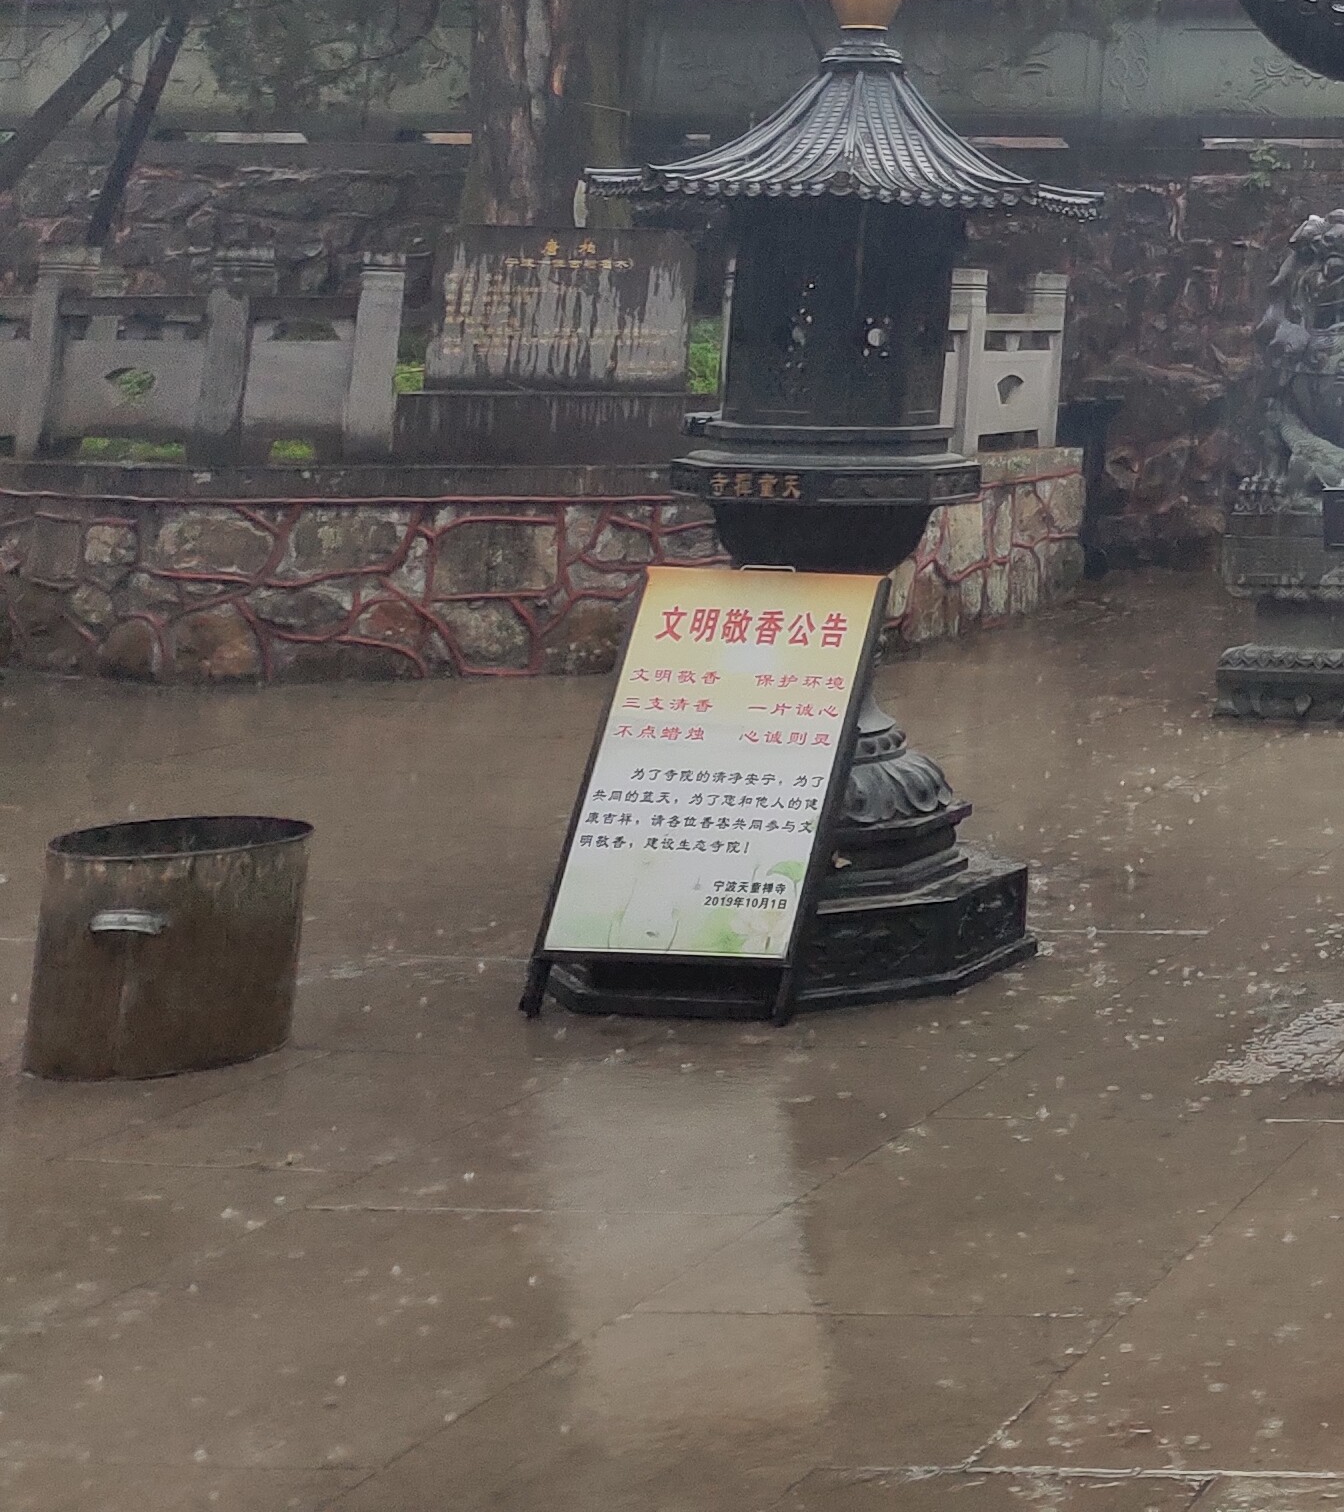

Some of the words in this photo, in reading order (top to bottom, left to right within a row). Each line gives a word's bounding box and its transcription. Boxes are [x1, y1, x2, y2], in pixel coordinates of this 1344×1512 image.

[655, 605, 848, 648] 文明敬香公告
[629, 668, 721, 684] 文明敬香
[755, 674, 846, 691] 保护环境
[622, 697, 714, 713] 三支清香
[748, 703, 839, 718] 一片诚心
[613, 725, 705, 742] 不点蜡烛
[739, 730, 832, 747] 心诚则灵
[713, 880, 786, 895] 宁波天童禅寺
[704, 895, 788, 910] 2019年10月1日
